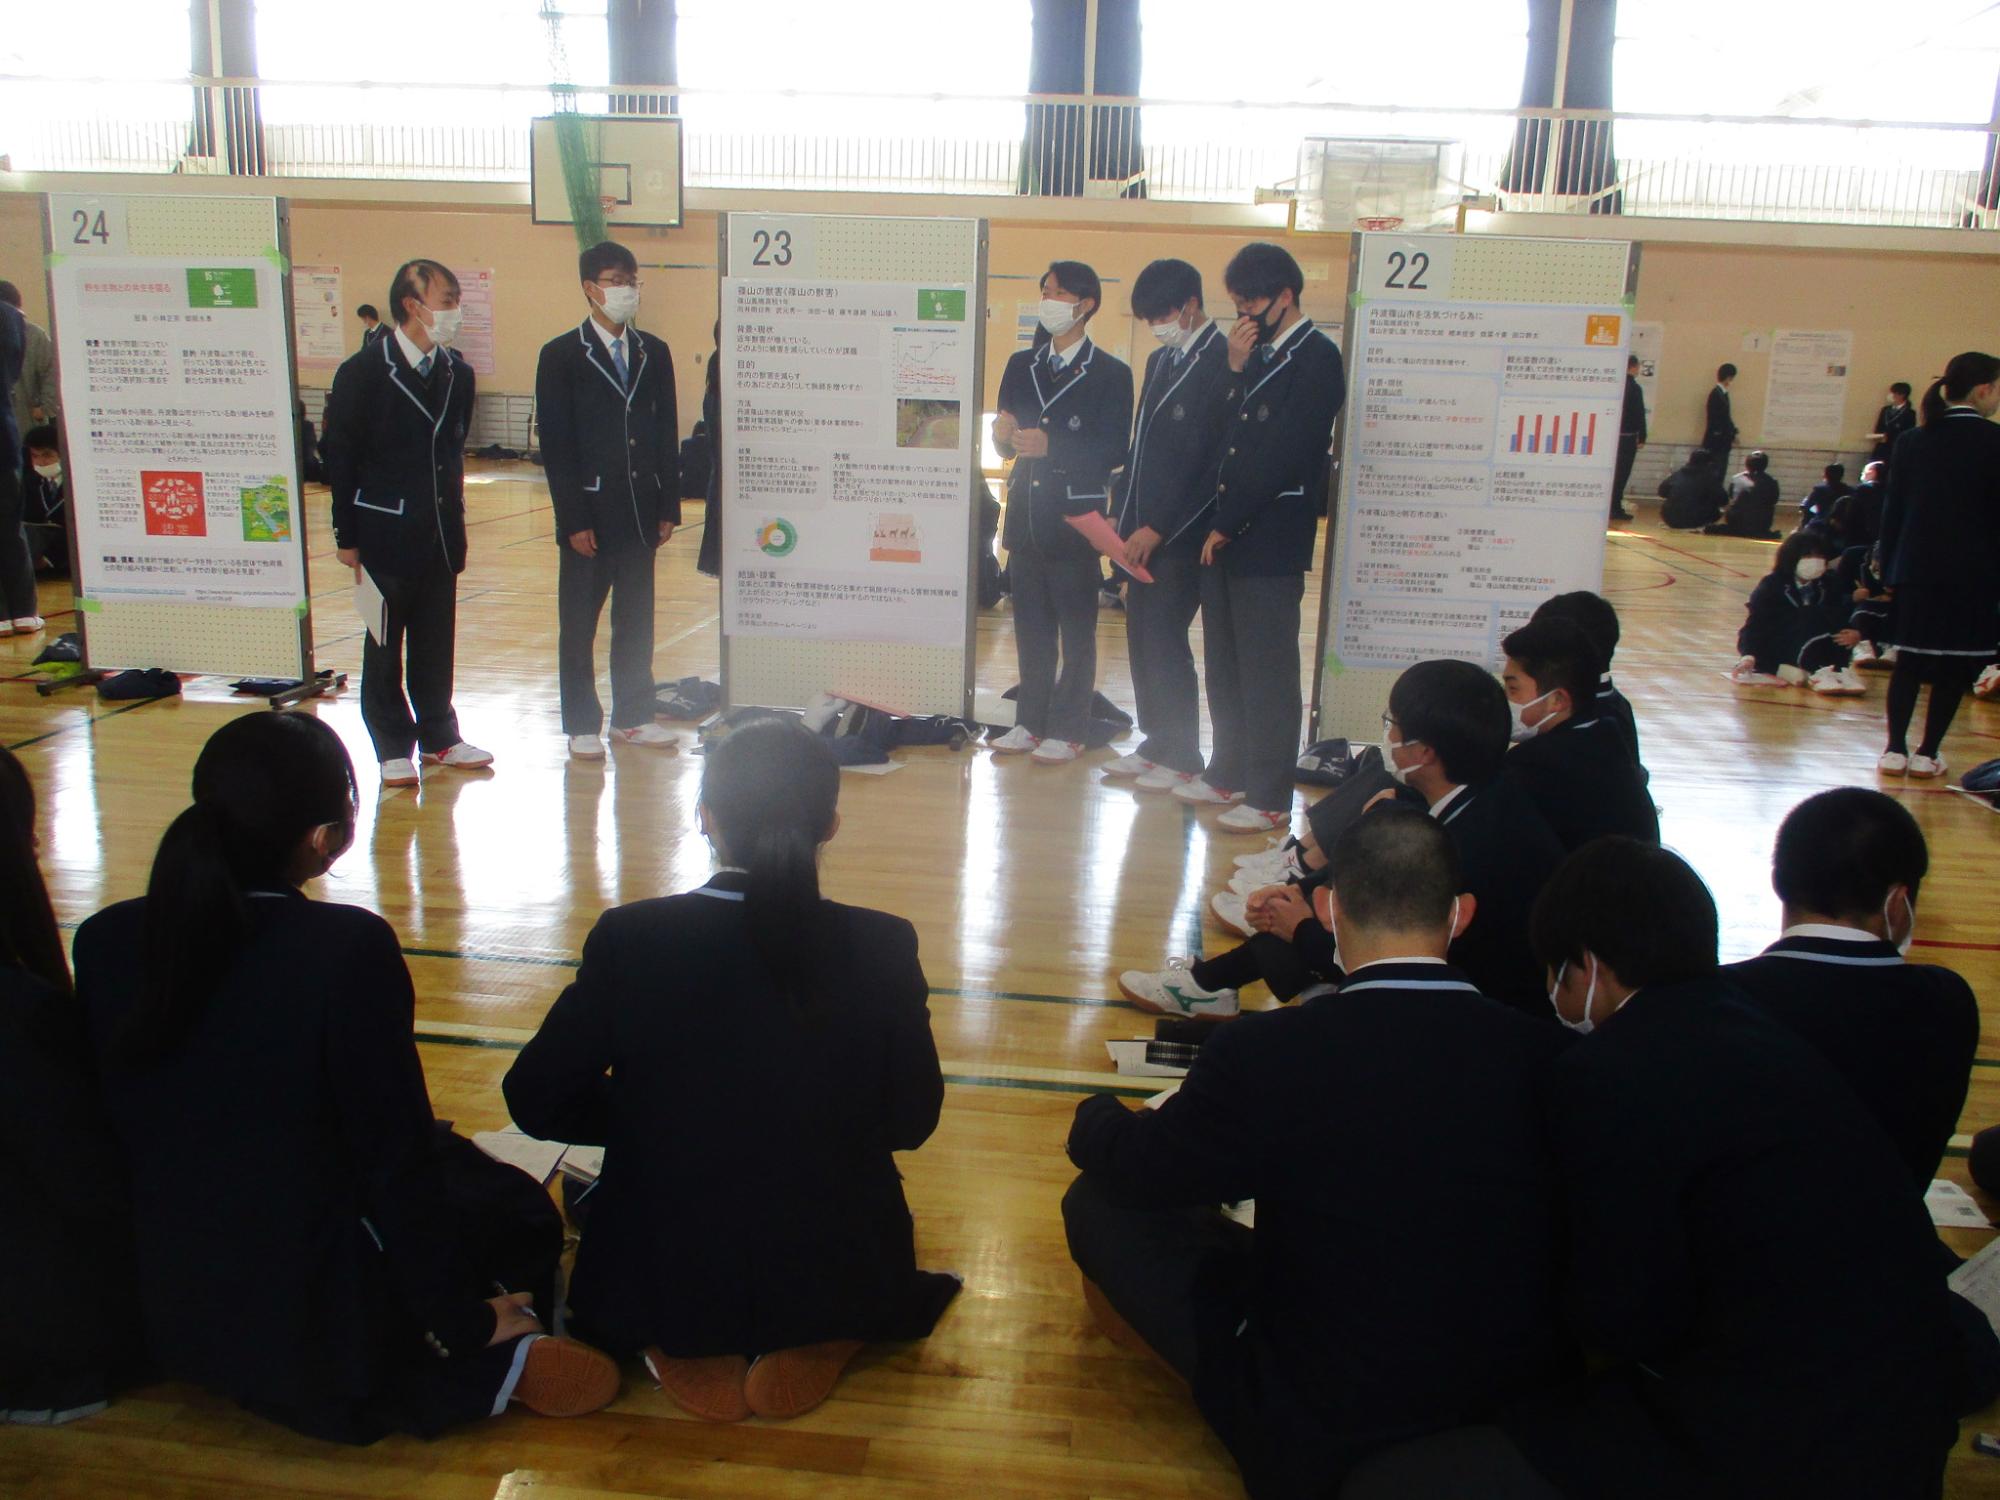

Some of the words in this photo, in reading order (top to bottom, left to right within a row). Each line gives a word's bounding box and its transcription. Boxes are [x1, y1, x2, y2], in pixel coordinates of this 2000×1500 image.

[72, 209, 110, 245] 24
[752, 229, 793, 267] 23
[1385, 251, 1430, 290] 22
[737, 360, 755, 369] 目的
